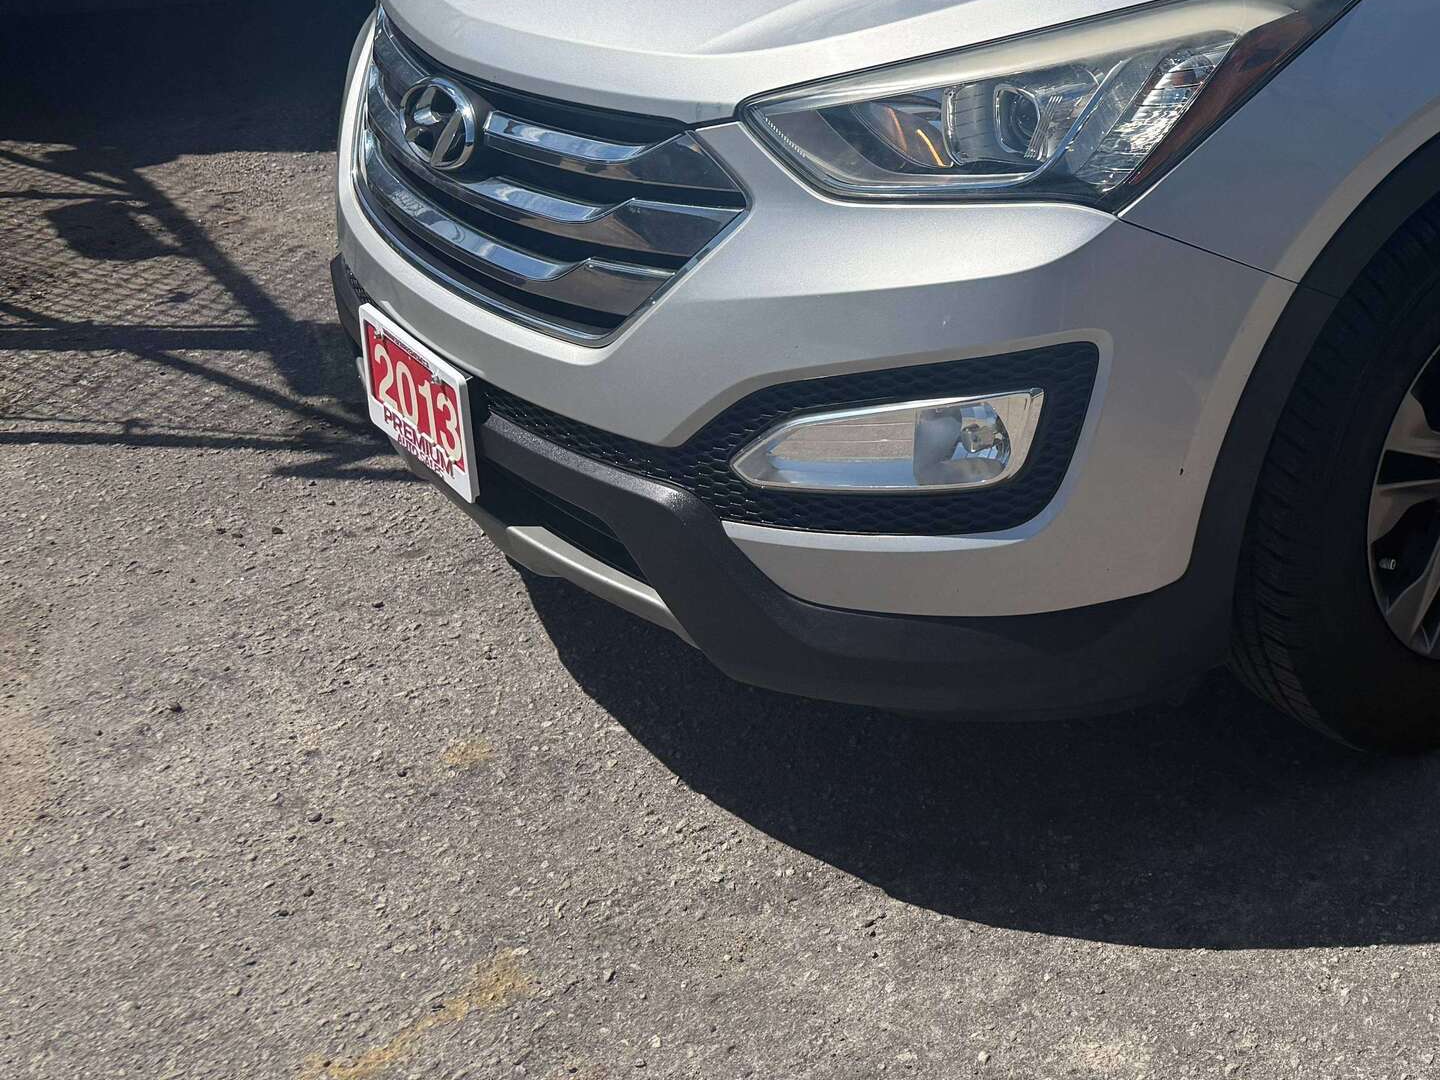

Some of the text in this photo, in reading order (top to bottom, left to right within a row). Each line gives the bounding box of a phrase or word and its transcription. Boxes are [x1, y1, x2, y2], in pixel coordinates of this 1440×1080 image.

[374, 343, 462, 463] 2013
[383, 406, 456, 480] PREMIUM
[397, 436, 418, 456] AUTO
